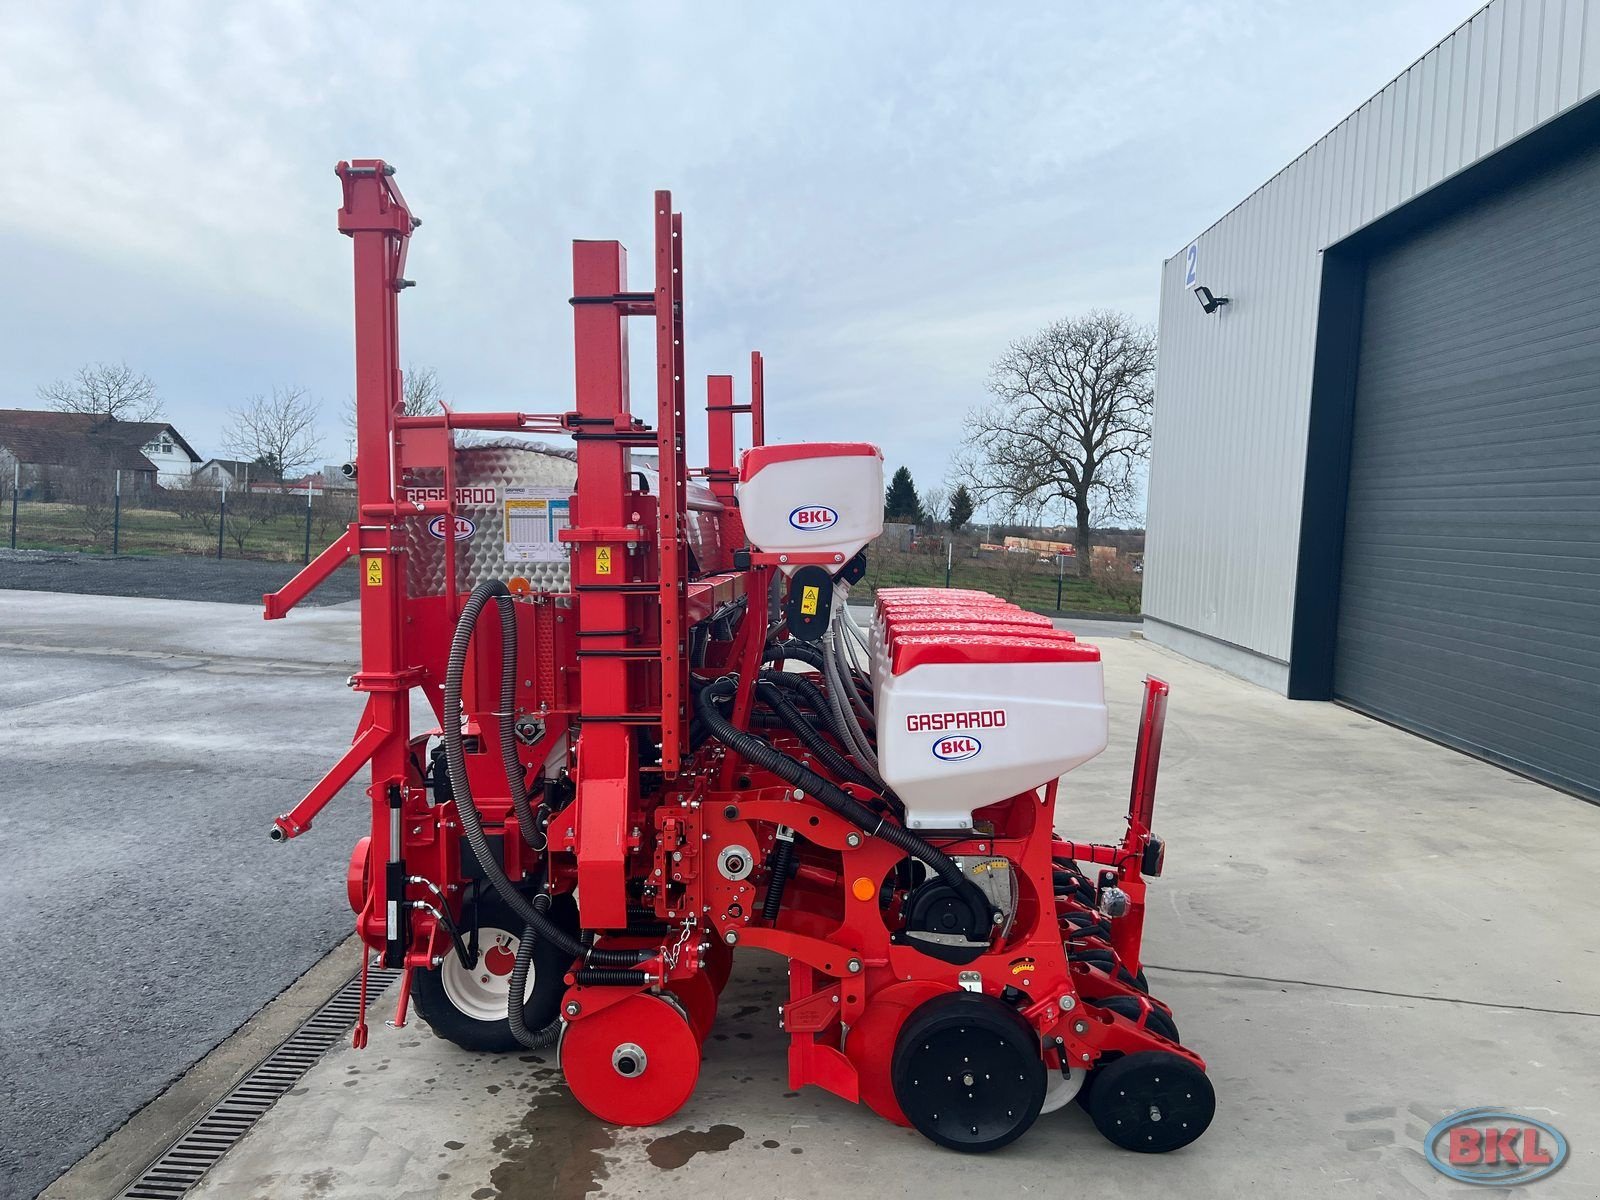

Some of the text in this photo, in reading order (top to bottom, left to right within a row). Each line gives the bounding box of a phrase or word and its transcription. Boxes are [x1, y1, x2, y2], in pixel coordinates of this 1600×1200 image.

[1186, 244, 1197, 286] 2
[798, 510, 832, 524] BKL
[906, 710, 1006, 732] GASPARDO
[941, 739, 976, 755] BKL
